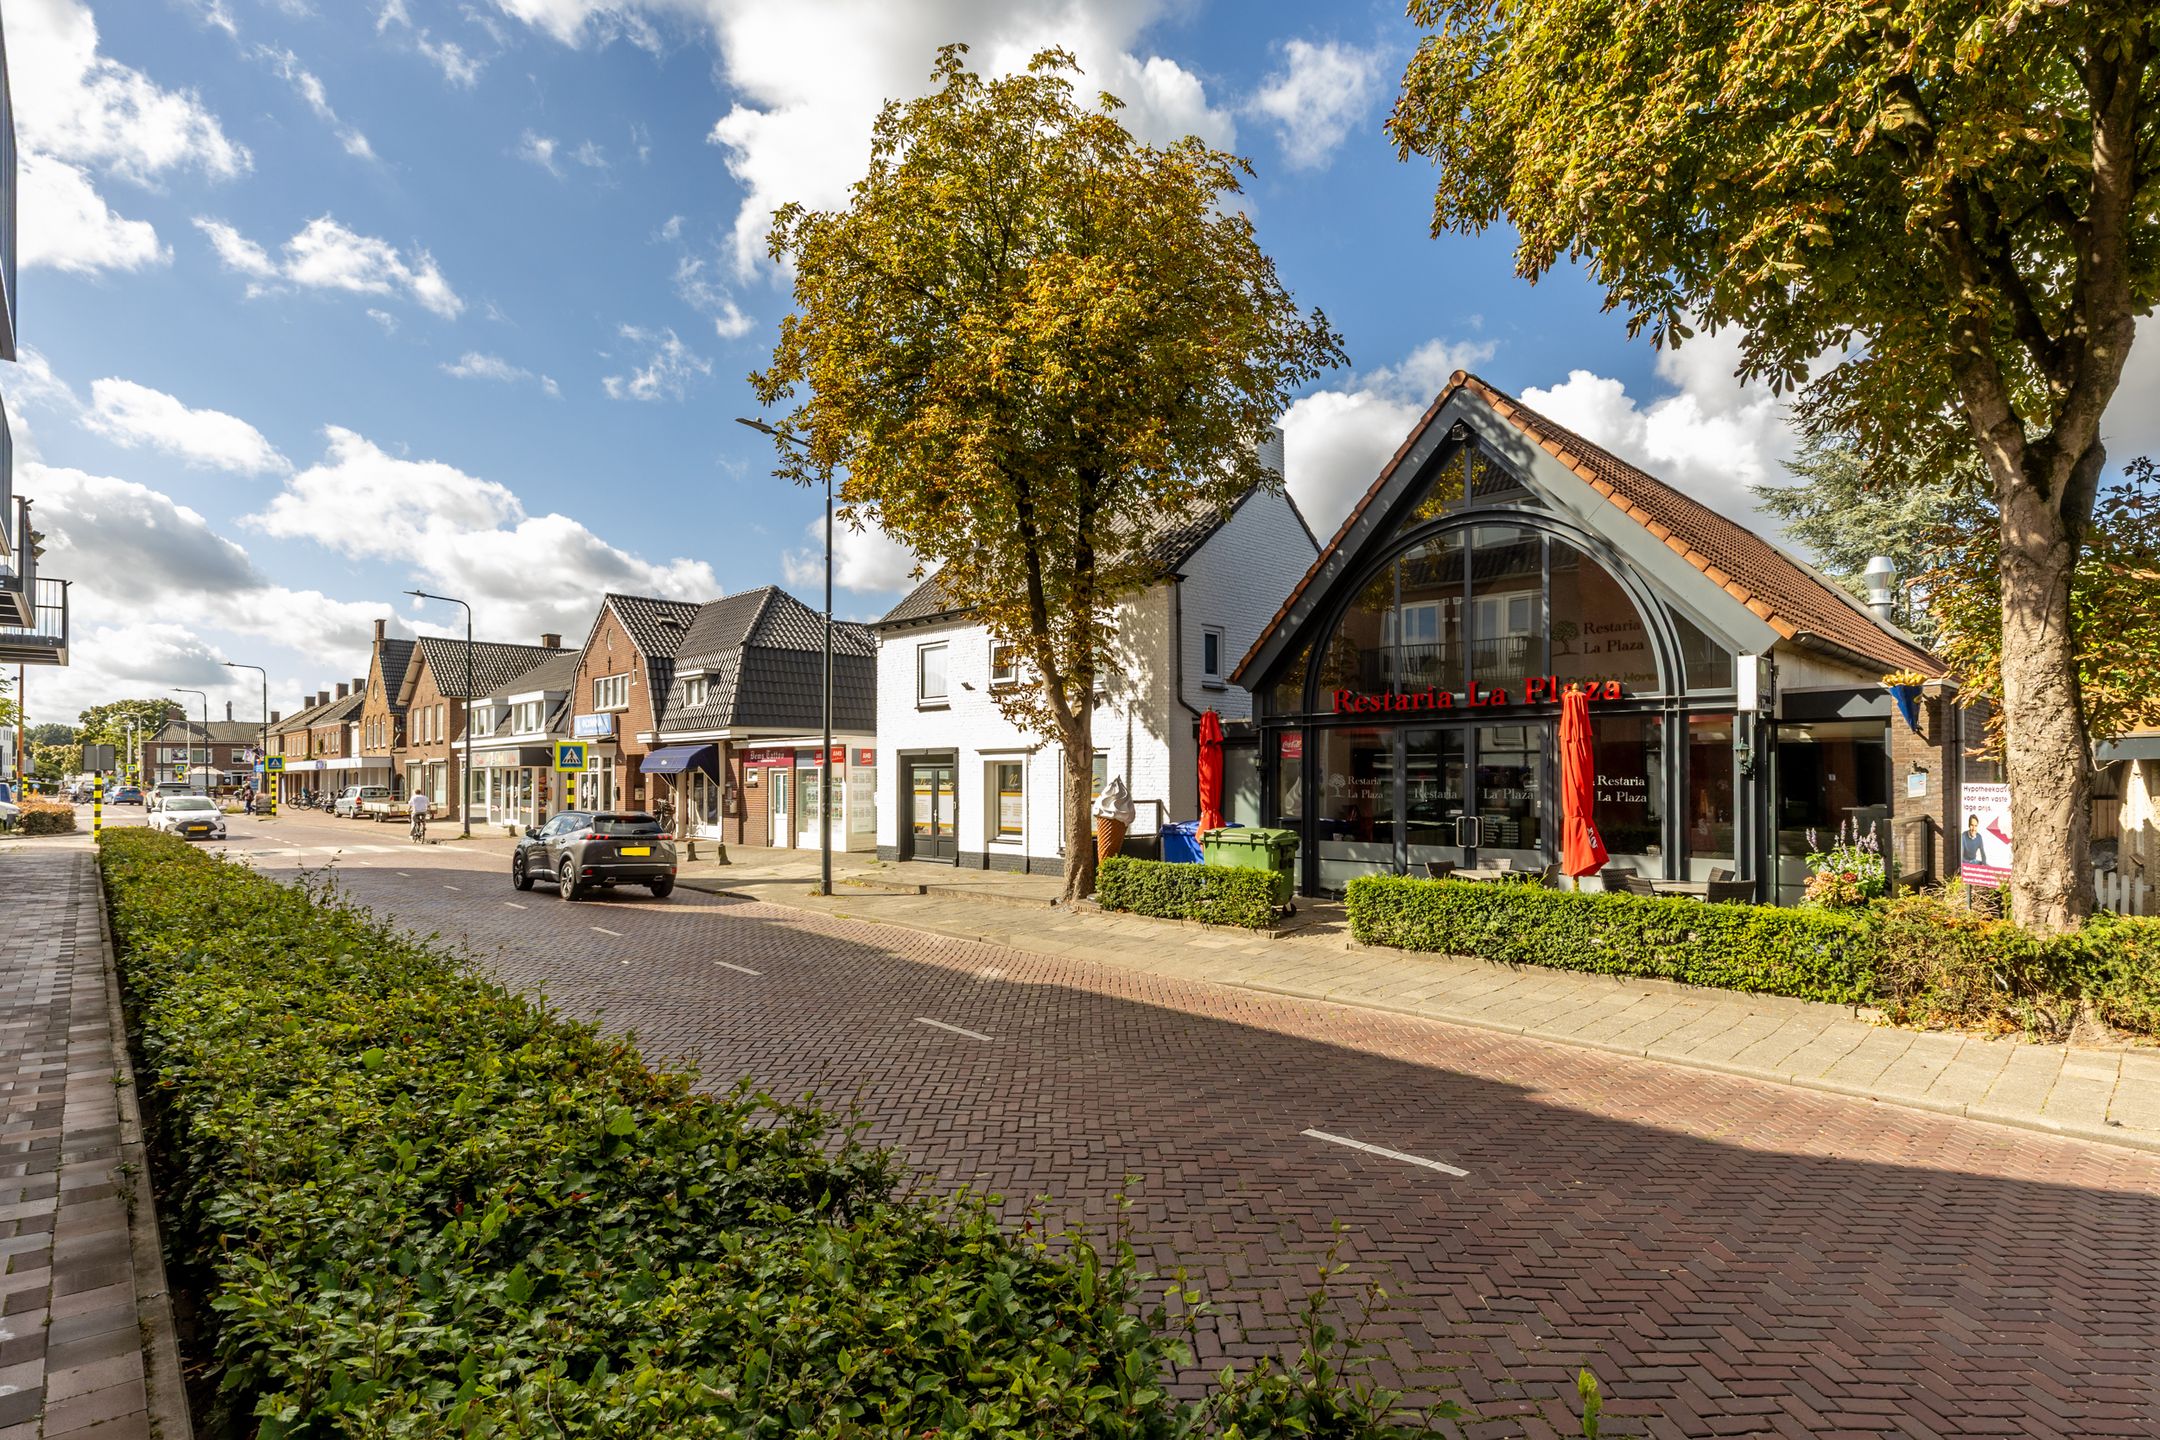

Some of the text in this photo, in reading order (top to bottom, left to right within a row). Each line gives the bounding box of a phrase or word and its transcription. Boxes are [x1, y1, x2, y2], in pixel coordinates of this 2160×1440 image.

[1583, 620, 1641, 635] Restaria
[1584, 639, 1645, 654] La Plaza
[1333, 683, 1454, 714] Restaria
[1466, 680, 1505, 707] La
[1347, 776, 1382, 785] Restaria
[1597, 775, 1645, 786] Restaria
[1347, 789, 1383, 799] La Plaza
[1414, 788, 1534, 800] Restaria La Plaza
[1964, 785, 2008, 793] Hypotheekadv
[1597, 790, 1647, 803] La Plaza
